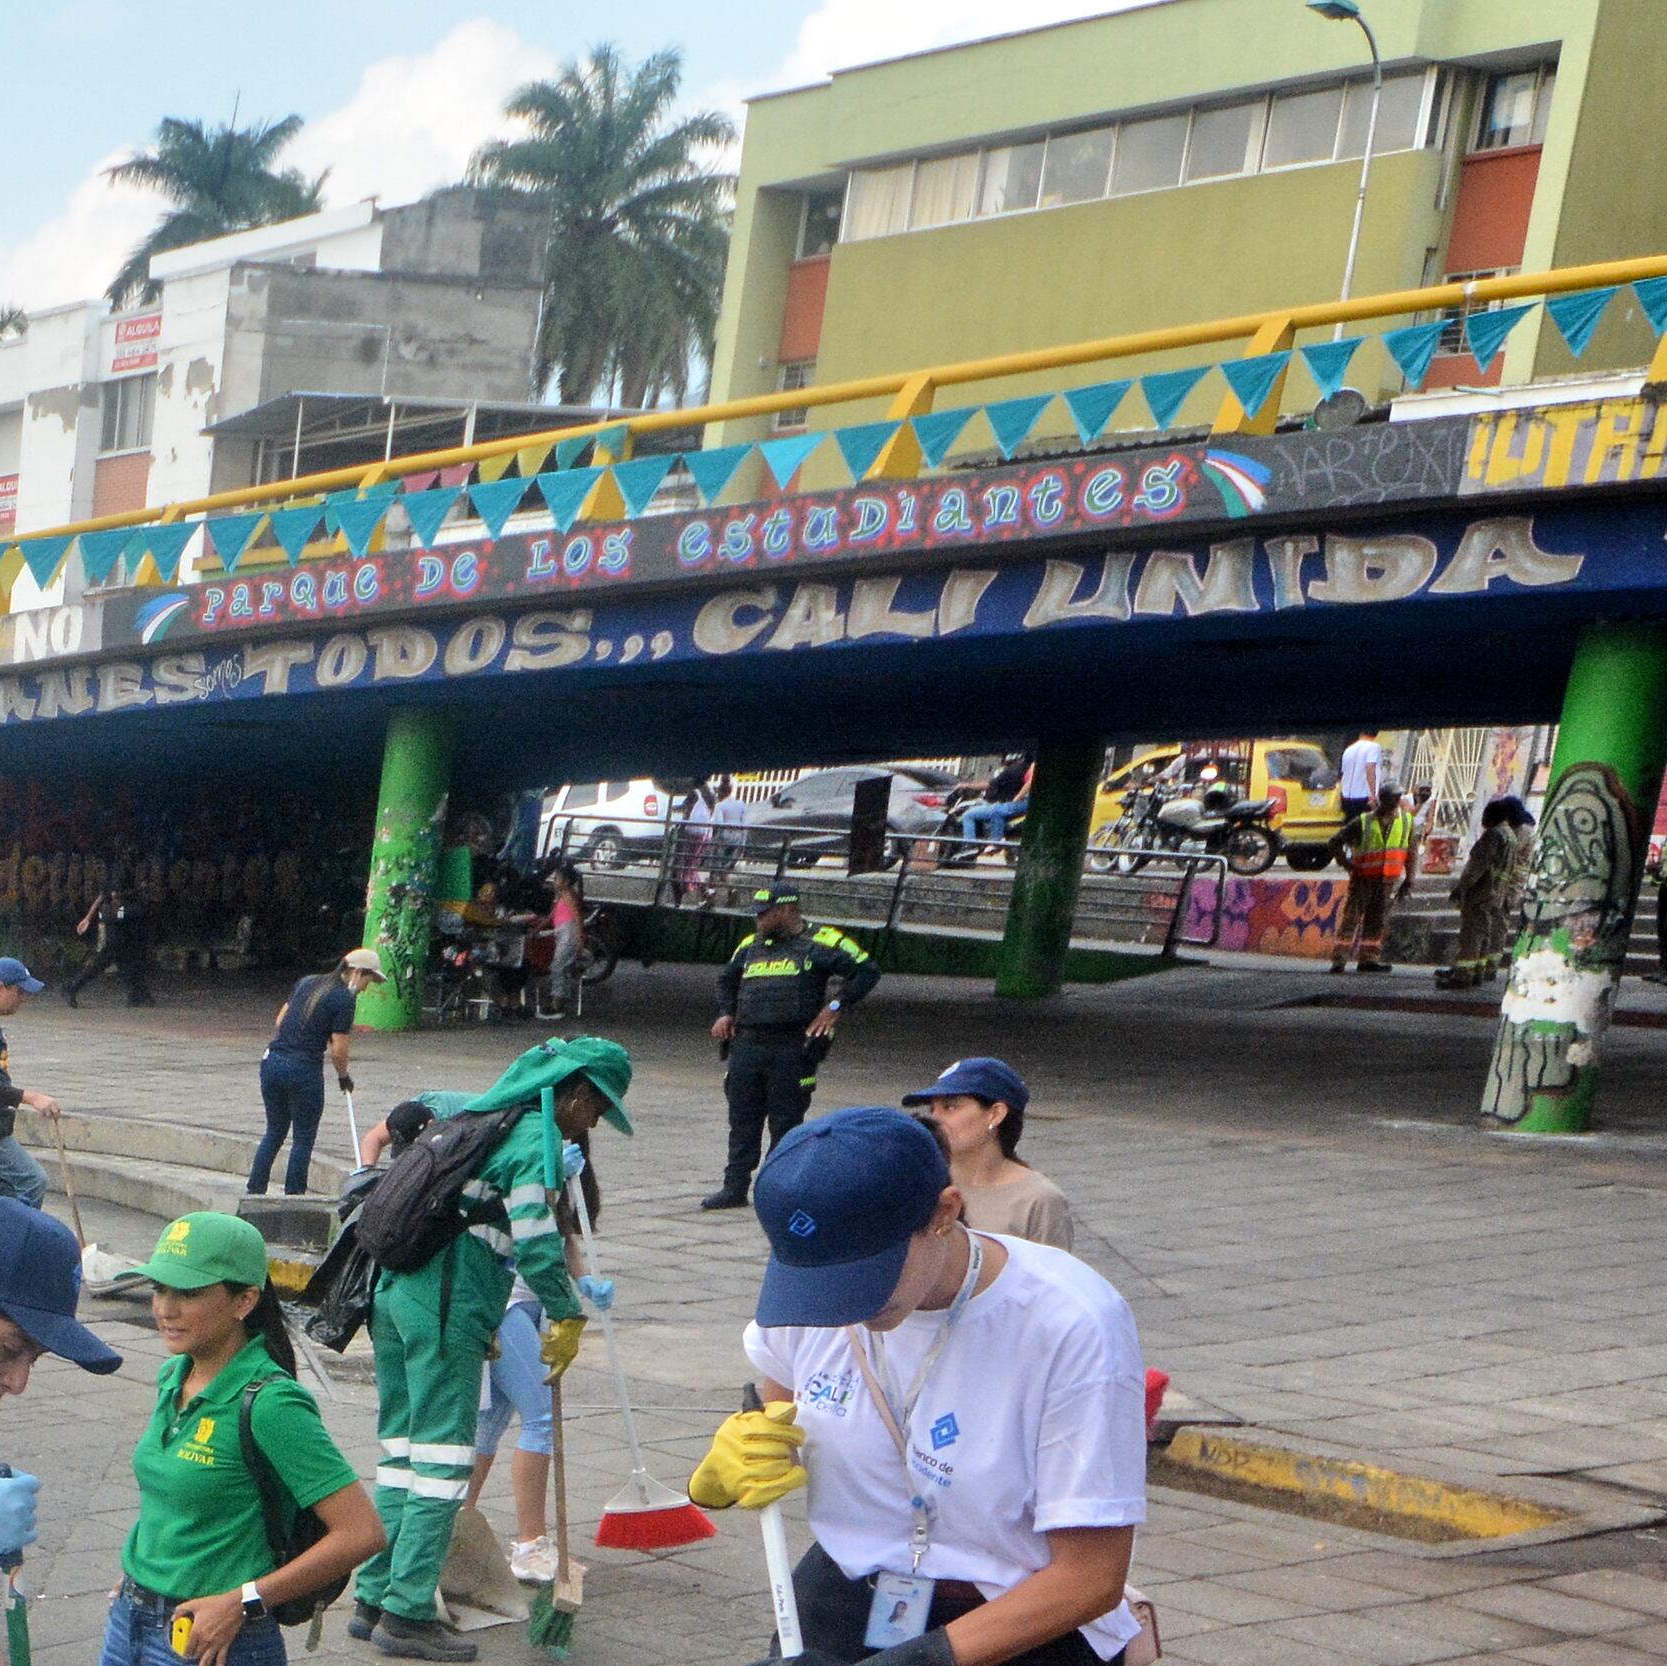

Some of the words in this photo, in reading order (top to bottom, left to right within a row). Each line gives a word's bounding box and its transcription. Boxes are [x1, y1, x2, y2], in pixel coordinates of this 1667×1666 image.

[693, 567, 999, 655] CALI
[1023, 517, 1584, 628] UNIDA
[14, 606, 83, 664] NO
[809, 1378, 849, 1405] CALI
[177, 1447, 215, 1466] BOLIVAR
[938, 1461, 955, 1476] de
